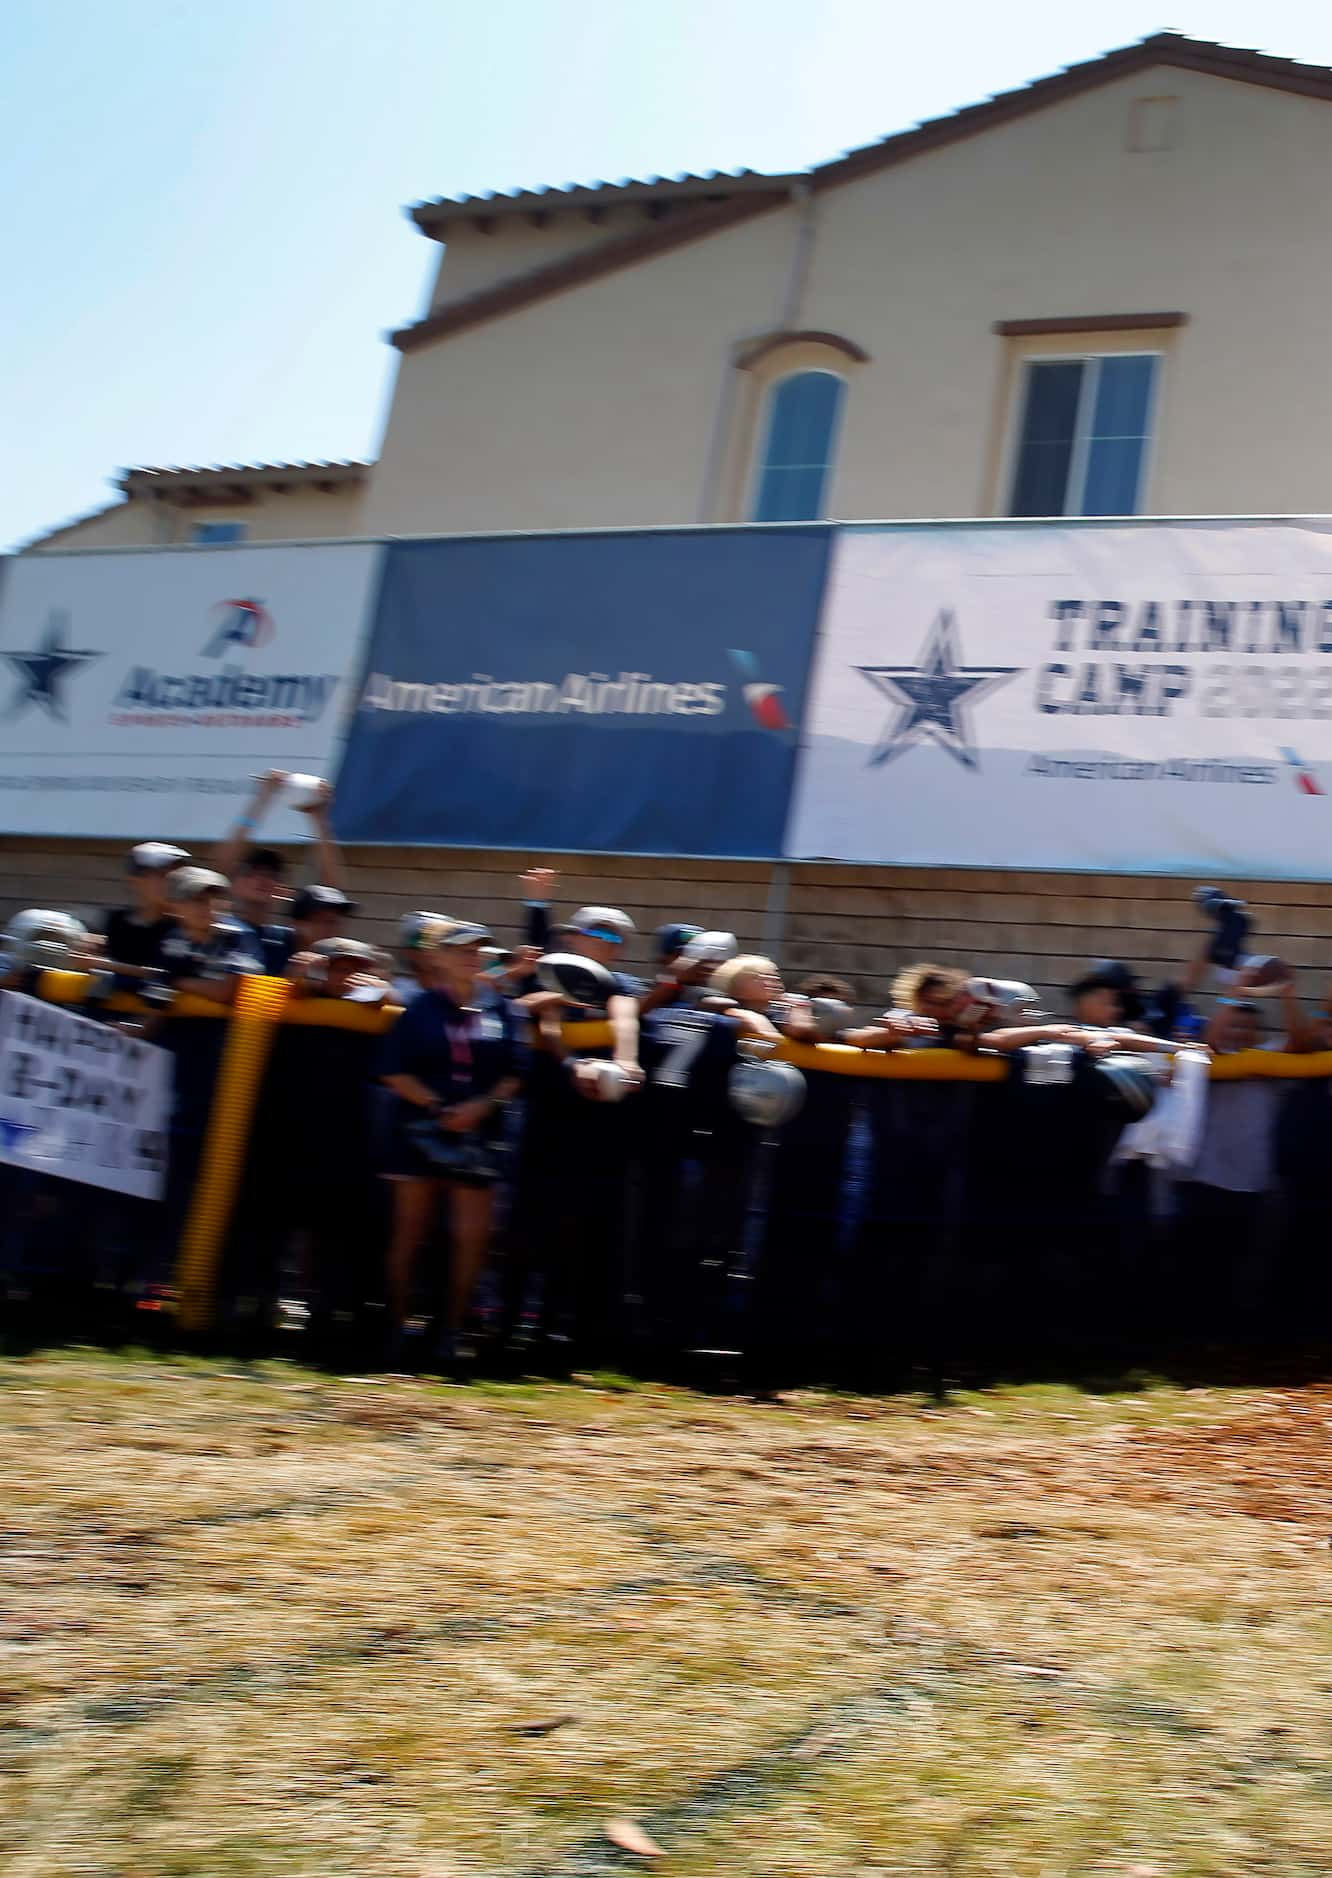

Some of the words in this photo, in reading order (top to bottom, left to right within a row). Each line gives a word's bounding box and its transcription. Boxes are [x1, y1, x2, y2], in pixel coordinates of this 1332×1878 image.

[113, 665, 340, 722] Academy
[364, 671, 558, 714] American
[559, 671, 727, 716] Airlines
[1036, 662, 1192, 717] CAMP
[1022, 753, 1160, 780] American
[1161, 757, 1280, 785] Airlines
[653, 1021, 712, 1088] 7
